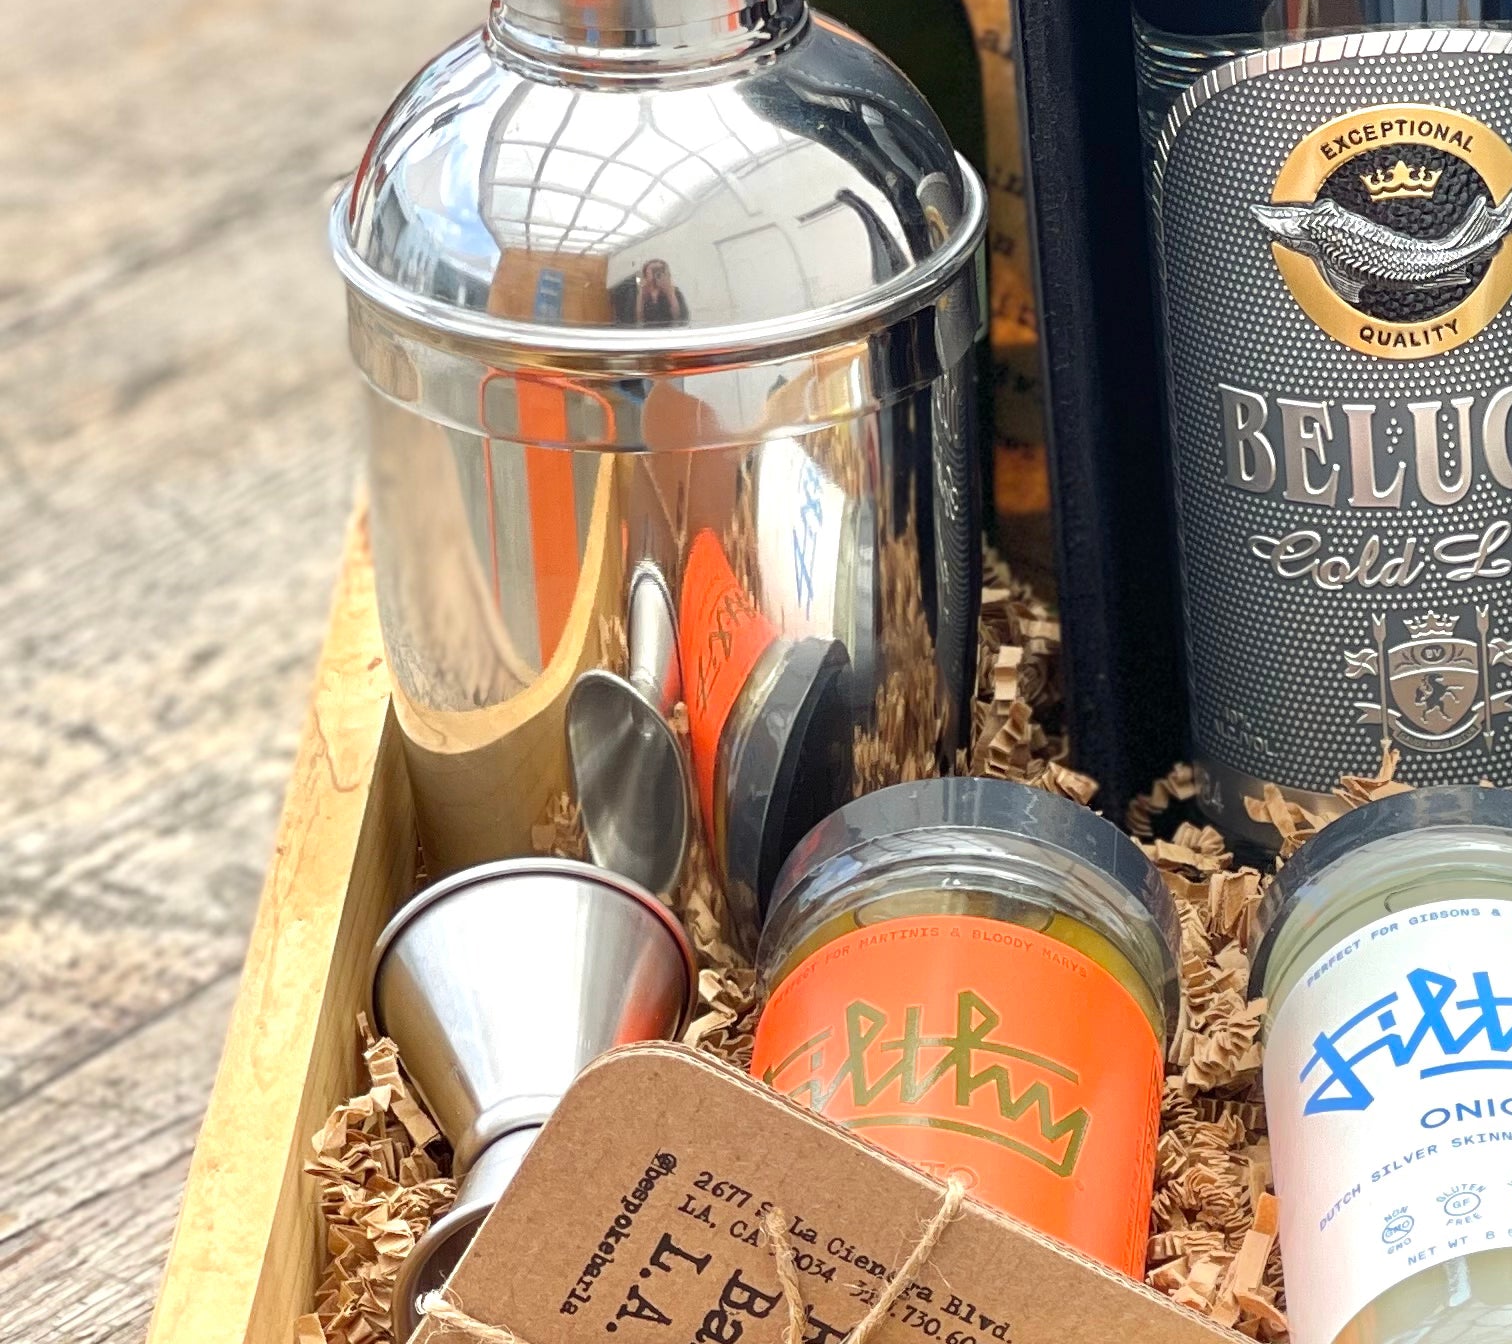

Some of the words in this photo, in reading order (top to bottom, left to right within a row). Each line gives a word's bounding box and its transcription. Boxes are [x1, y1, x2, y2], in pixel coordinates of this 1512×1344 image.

[1321, 119, 1474, 160] EXCEPTIONAL
[1359, 318, 1461, 348] QUALITY
[859, 927, 940, 950] MARTINIS
[950, 927, 961, 938] &
[972, 929, 1033, 953] BLOODY
[1042, 948, 1088, 978] MARYS
[1306, 939, 1361, 988] PERFECT
[1370, 922, 1399, 941] FOR
[1408, 907, 1481, 926] GIBSONS
[1491, 908, 1501, 917] &
[1319, 1183, 1362, 1232] DUTCH
[1371, 1144, 1439, 1183] SILVER
[1435, 1183, 1487, 1203] GLUTEN
[559, 1147, 678, 1316] @bespokebarla
[677, 1194, 717, 1229] LA,
[729, 1220, 760, 1248] CA
[1384, 1205, 1409, 1223] NON
[1445, 1213, 1483, 1226] FREE
[693, 1170, 754, 1208] 2677
[788, 1215, 818, 1245] La
[940, 1293, 1014, 1344] Blvd.
[1387, 1237, 1412, 1255] GMO
[1407, 1246, 1437, 1266] NET
[1448, 1235, 1469, 1249] WT
[605, 1232, 713, 1333] L.A.
